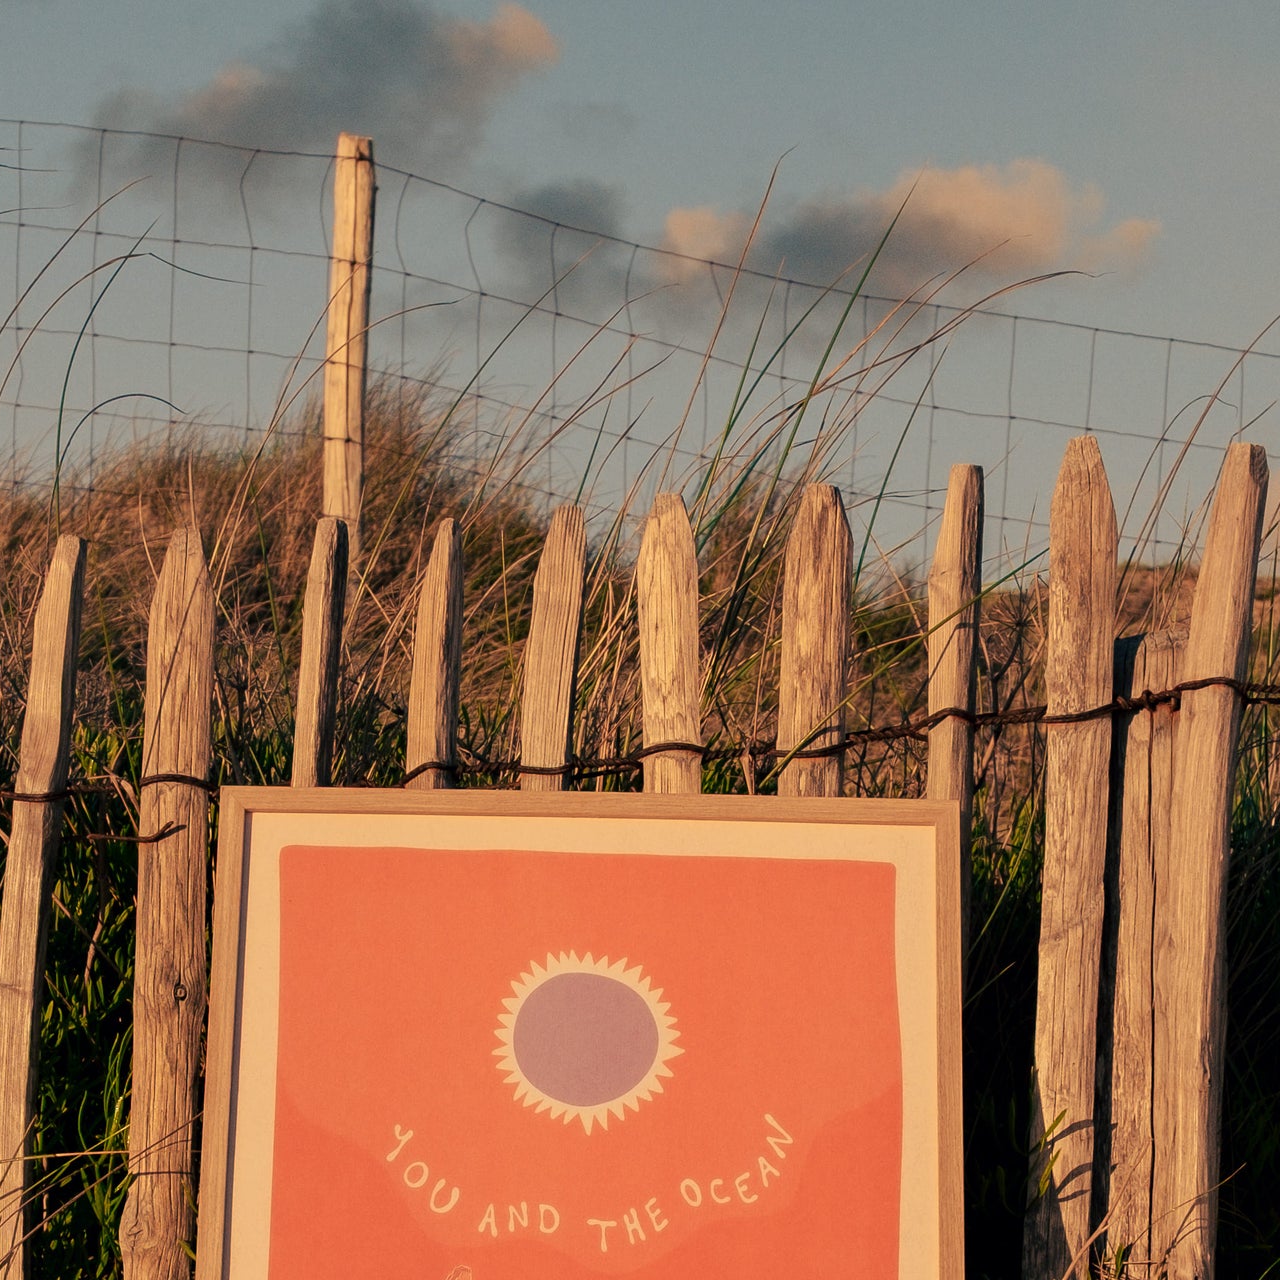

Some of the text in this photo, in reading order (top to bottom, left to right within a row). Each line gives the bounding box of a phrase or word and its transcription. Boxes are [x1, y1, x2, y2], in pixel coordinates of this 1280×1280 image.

[386, 1114, 794, 1252] YOU AND THE OCEAN
